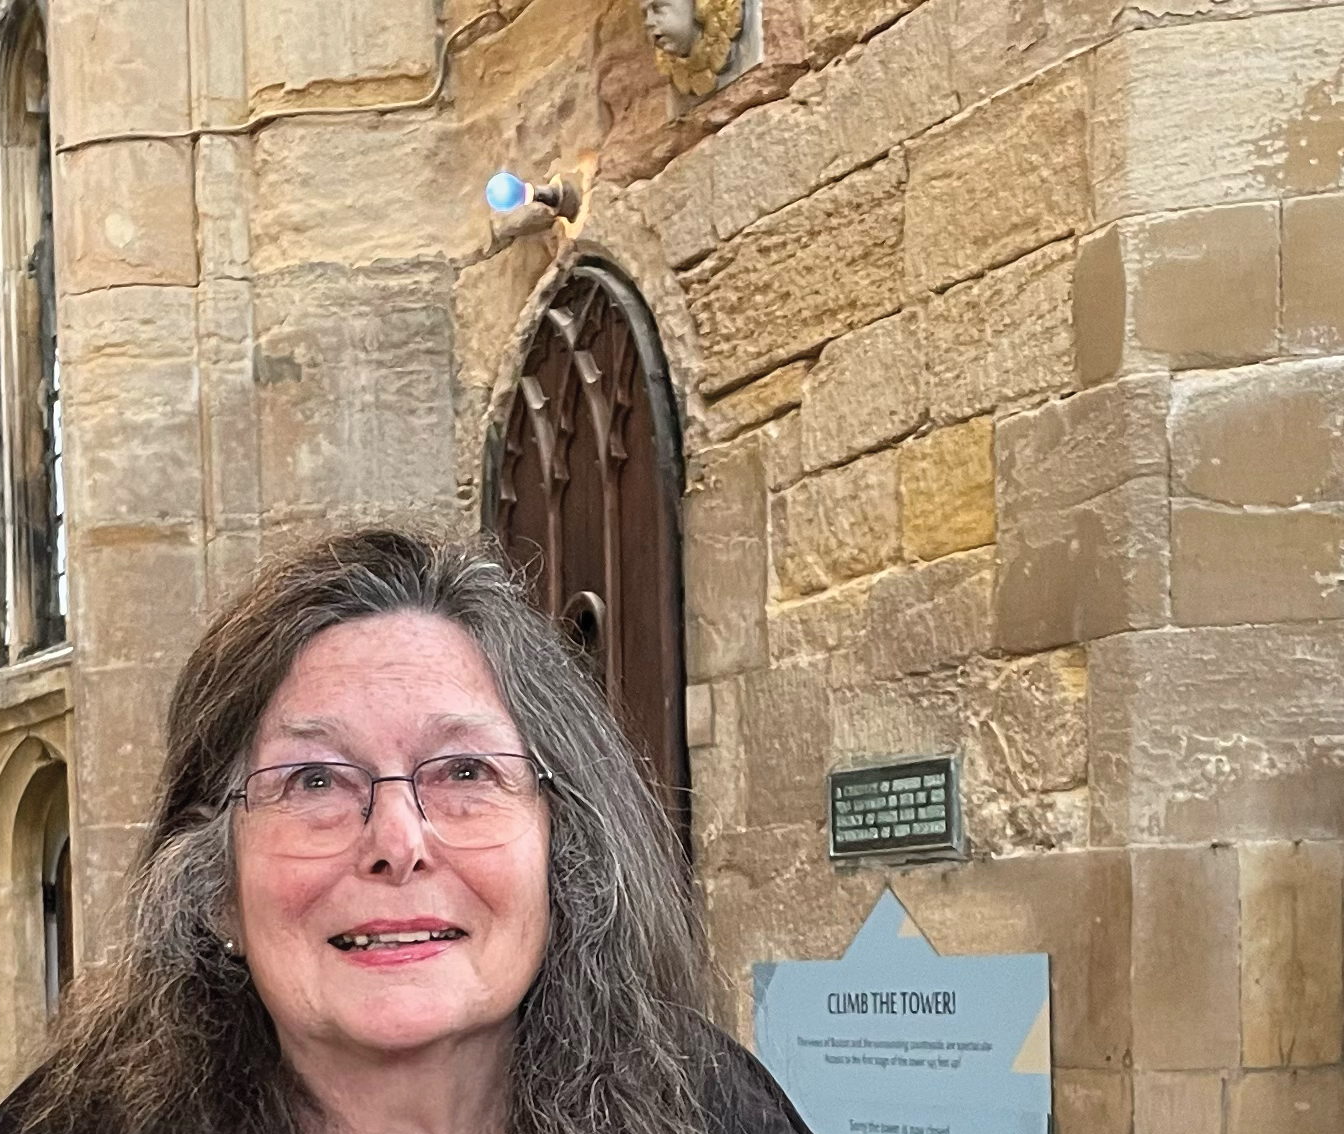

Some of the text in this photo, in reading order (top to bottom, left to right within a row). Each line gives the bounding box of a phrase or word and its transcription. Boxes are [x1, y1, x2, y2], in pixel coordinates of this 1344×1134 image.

[827, 991, 956, 1015] CLIMB THE TOWER!
